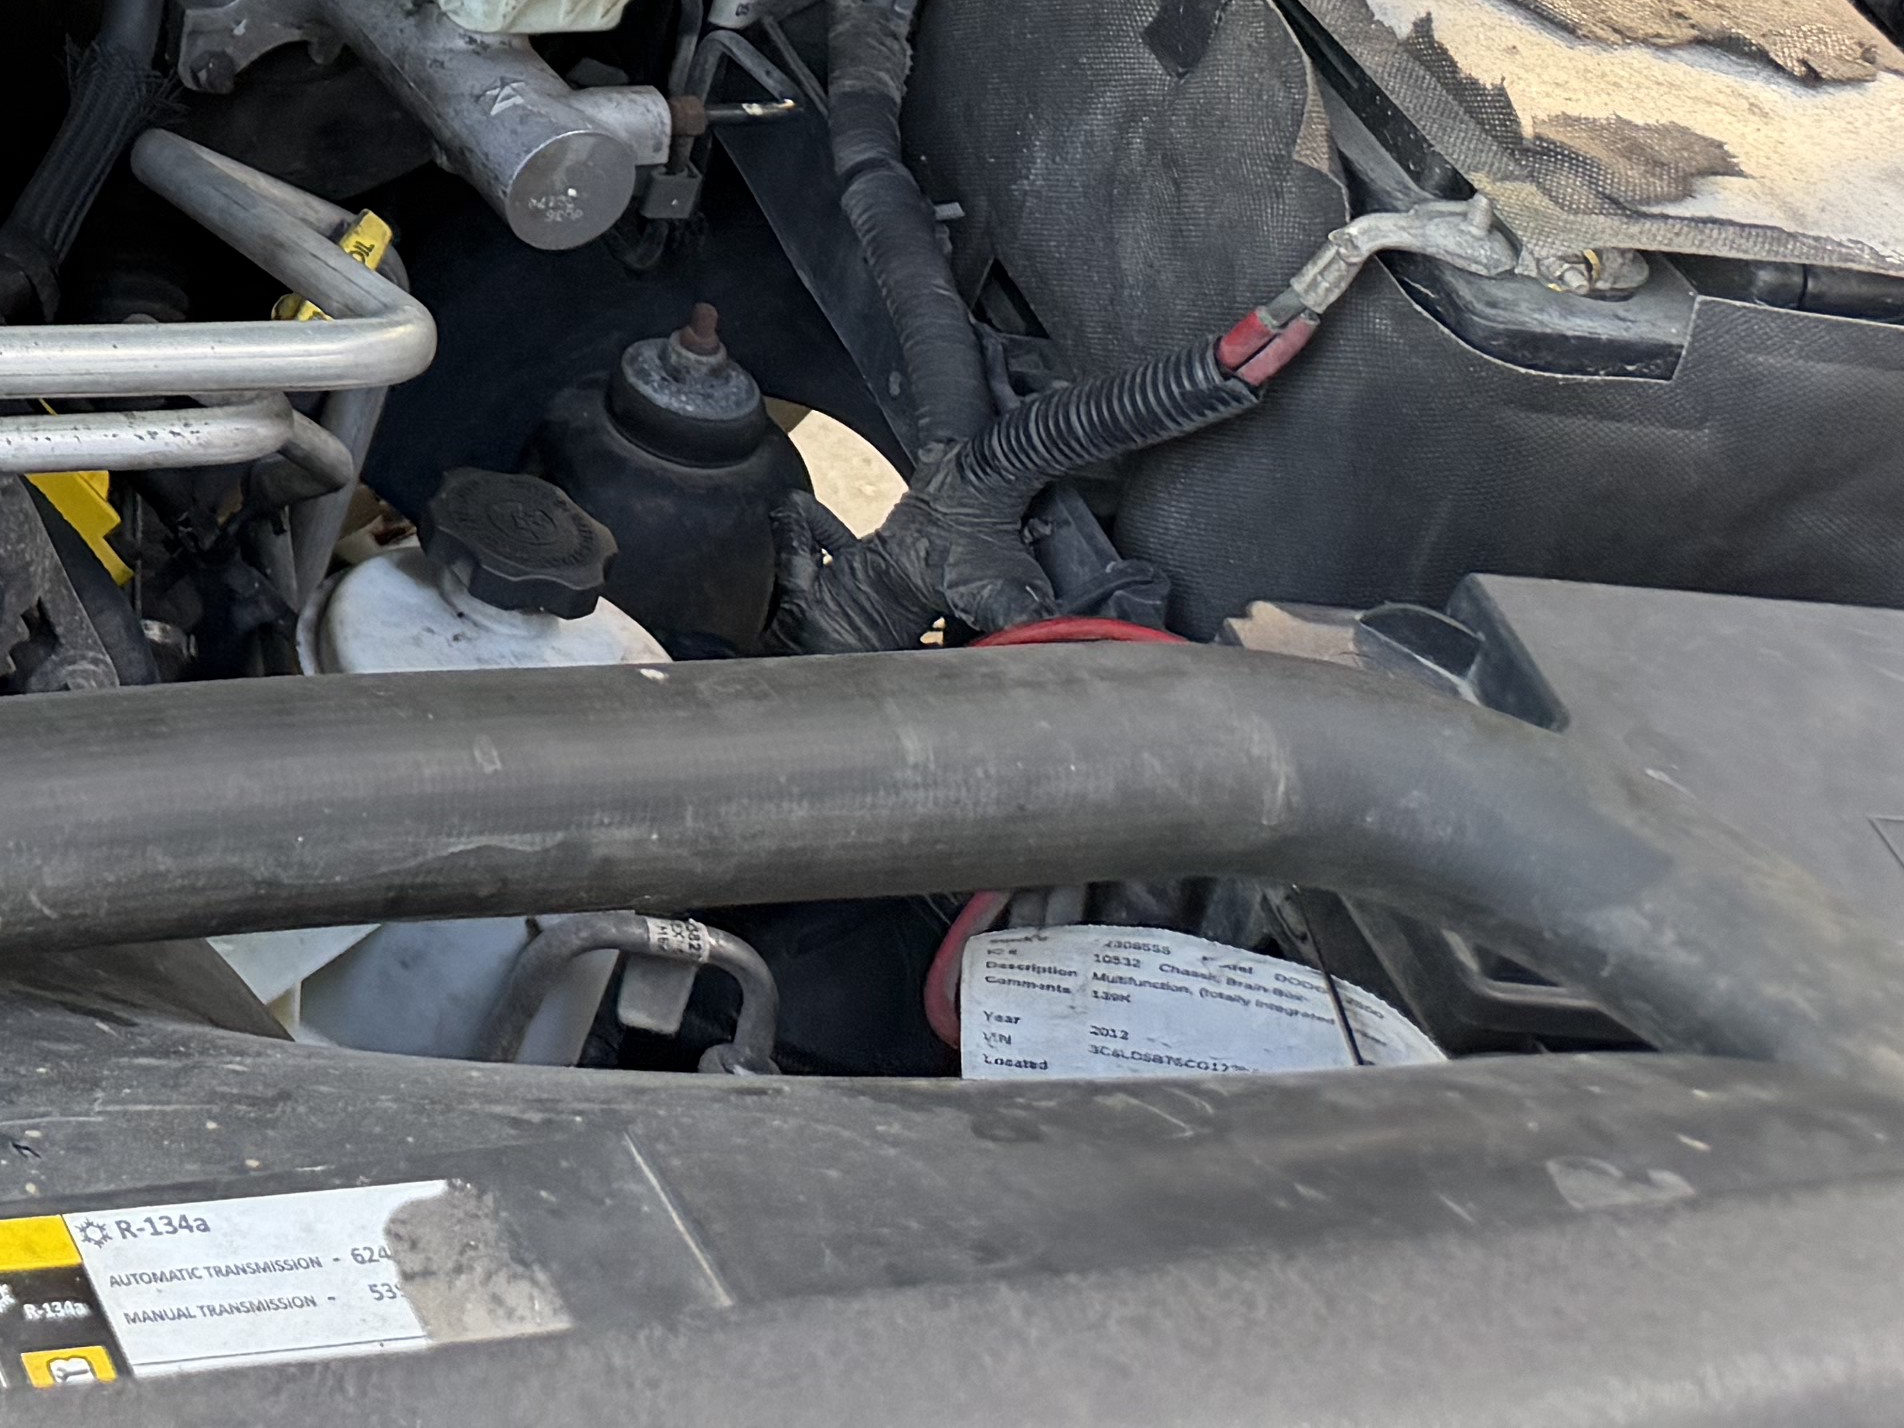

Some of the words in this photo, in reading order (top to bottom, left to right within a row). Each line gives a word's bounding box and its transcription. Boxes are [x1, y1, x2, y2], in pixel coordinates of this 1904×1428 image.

[985, 961, 1078, 978] Description
[985, 976, 1072, 994] Comments
[983, 1010, 1022, 1025] Year
[1089, 1025, 1130, 1041] 2012
[983, 1031, 1012, 1046] VIN
[983, 1053, 1049, 1071] Located
[114, 1213, 211, 1240] R-134a
[109, 1266, 203, 1288] AUTOMATIC
[205, 1256, 324, 1279] TRANSMISSION
[22, 1299, 92, 1322] R-134a
[123, 1306, 197, 1326] MANUAL
[199, 1294, 318, 1318] TRANSMISSION
